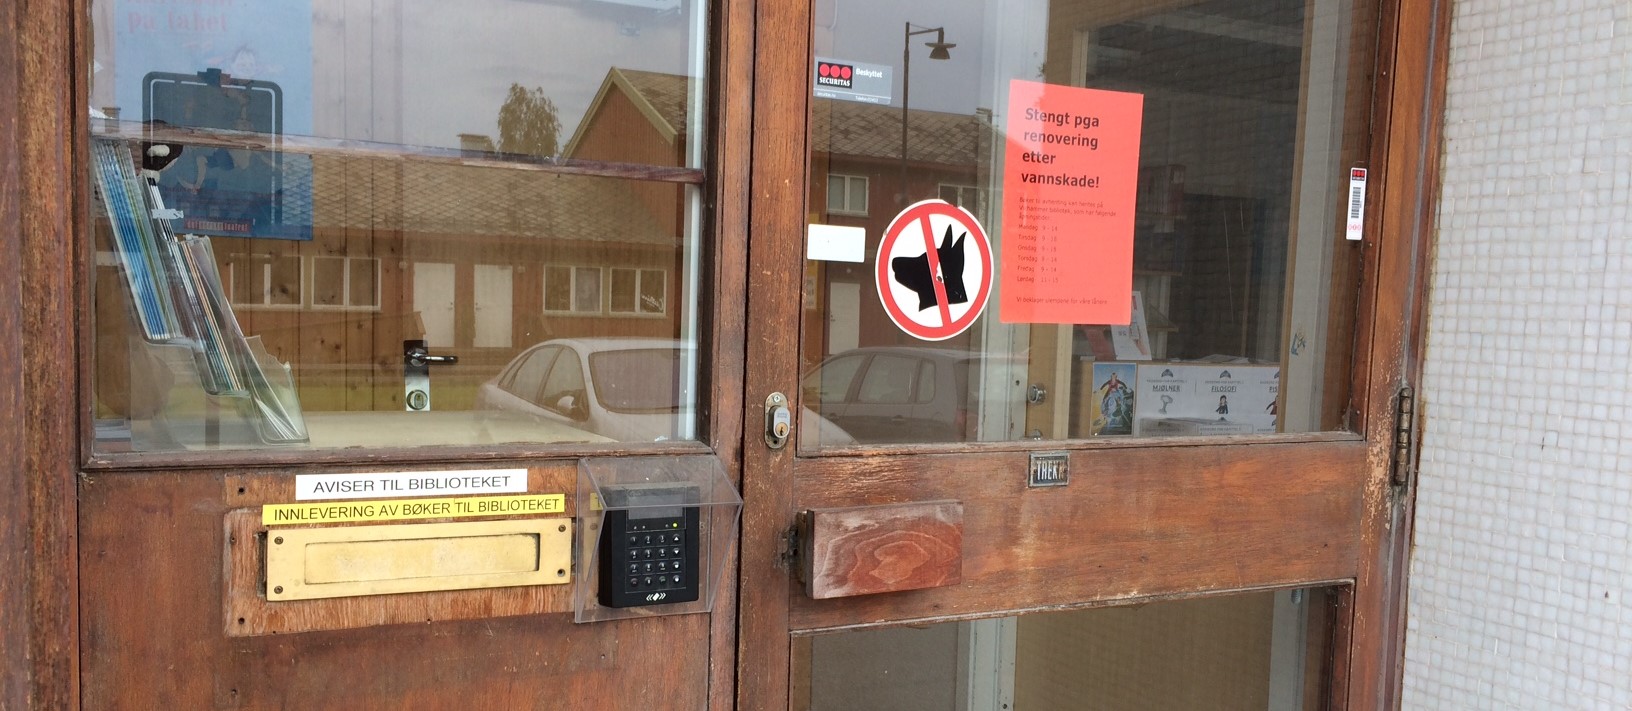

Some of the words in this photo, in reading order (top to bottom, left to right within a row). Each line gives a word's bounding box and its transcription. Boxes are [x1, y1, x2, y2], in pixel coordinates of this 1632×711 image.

[856, 68, 883, 78] Beskyttet
[819, 77, 850, 86] SECURITAS
[1025, 107, 1070, 127] Stengt
[1074, 115, 1100, 129] pga
[1024, 131, 1098, 151] renovering
[1022, 151, 1056, 164] etter
[1021, 173, 1100, 188] vannskade!
[1152, 384, 1181, 392] MJØLNER
[1211, 385, 1237, 393] FILOSOFI
[313, 480, 375, 498] AVISER
[379, 479, 404, 495] TIL
[408, 475, 511, 496] BIBLIOTEKET
[273, 505, 374, 521] INNLEVERING
[378, 503, 399, 516] AV
[402, 502, 451, 516] BØKER
[454, 501, 475, 514] TIL
[478, 497, 560, 514] BIBLIOTEKET
